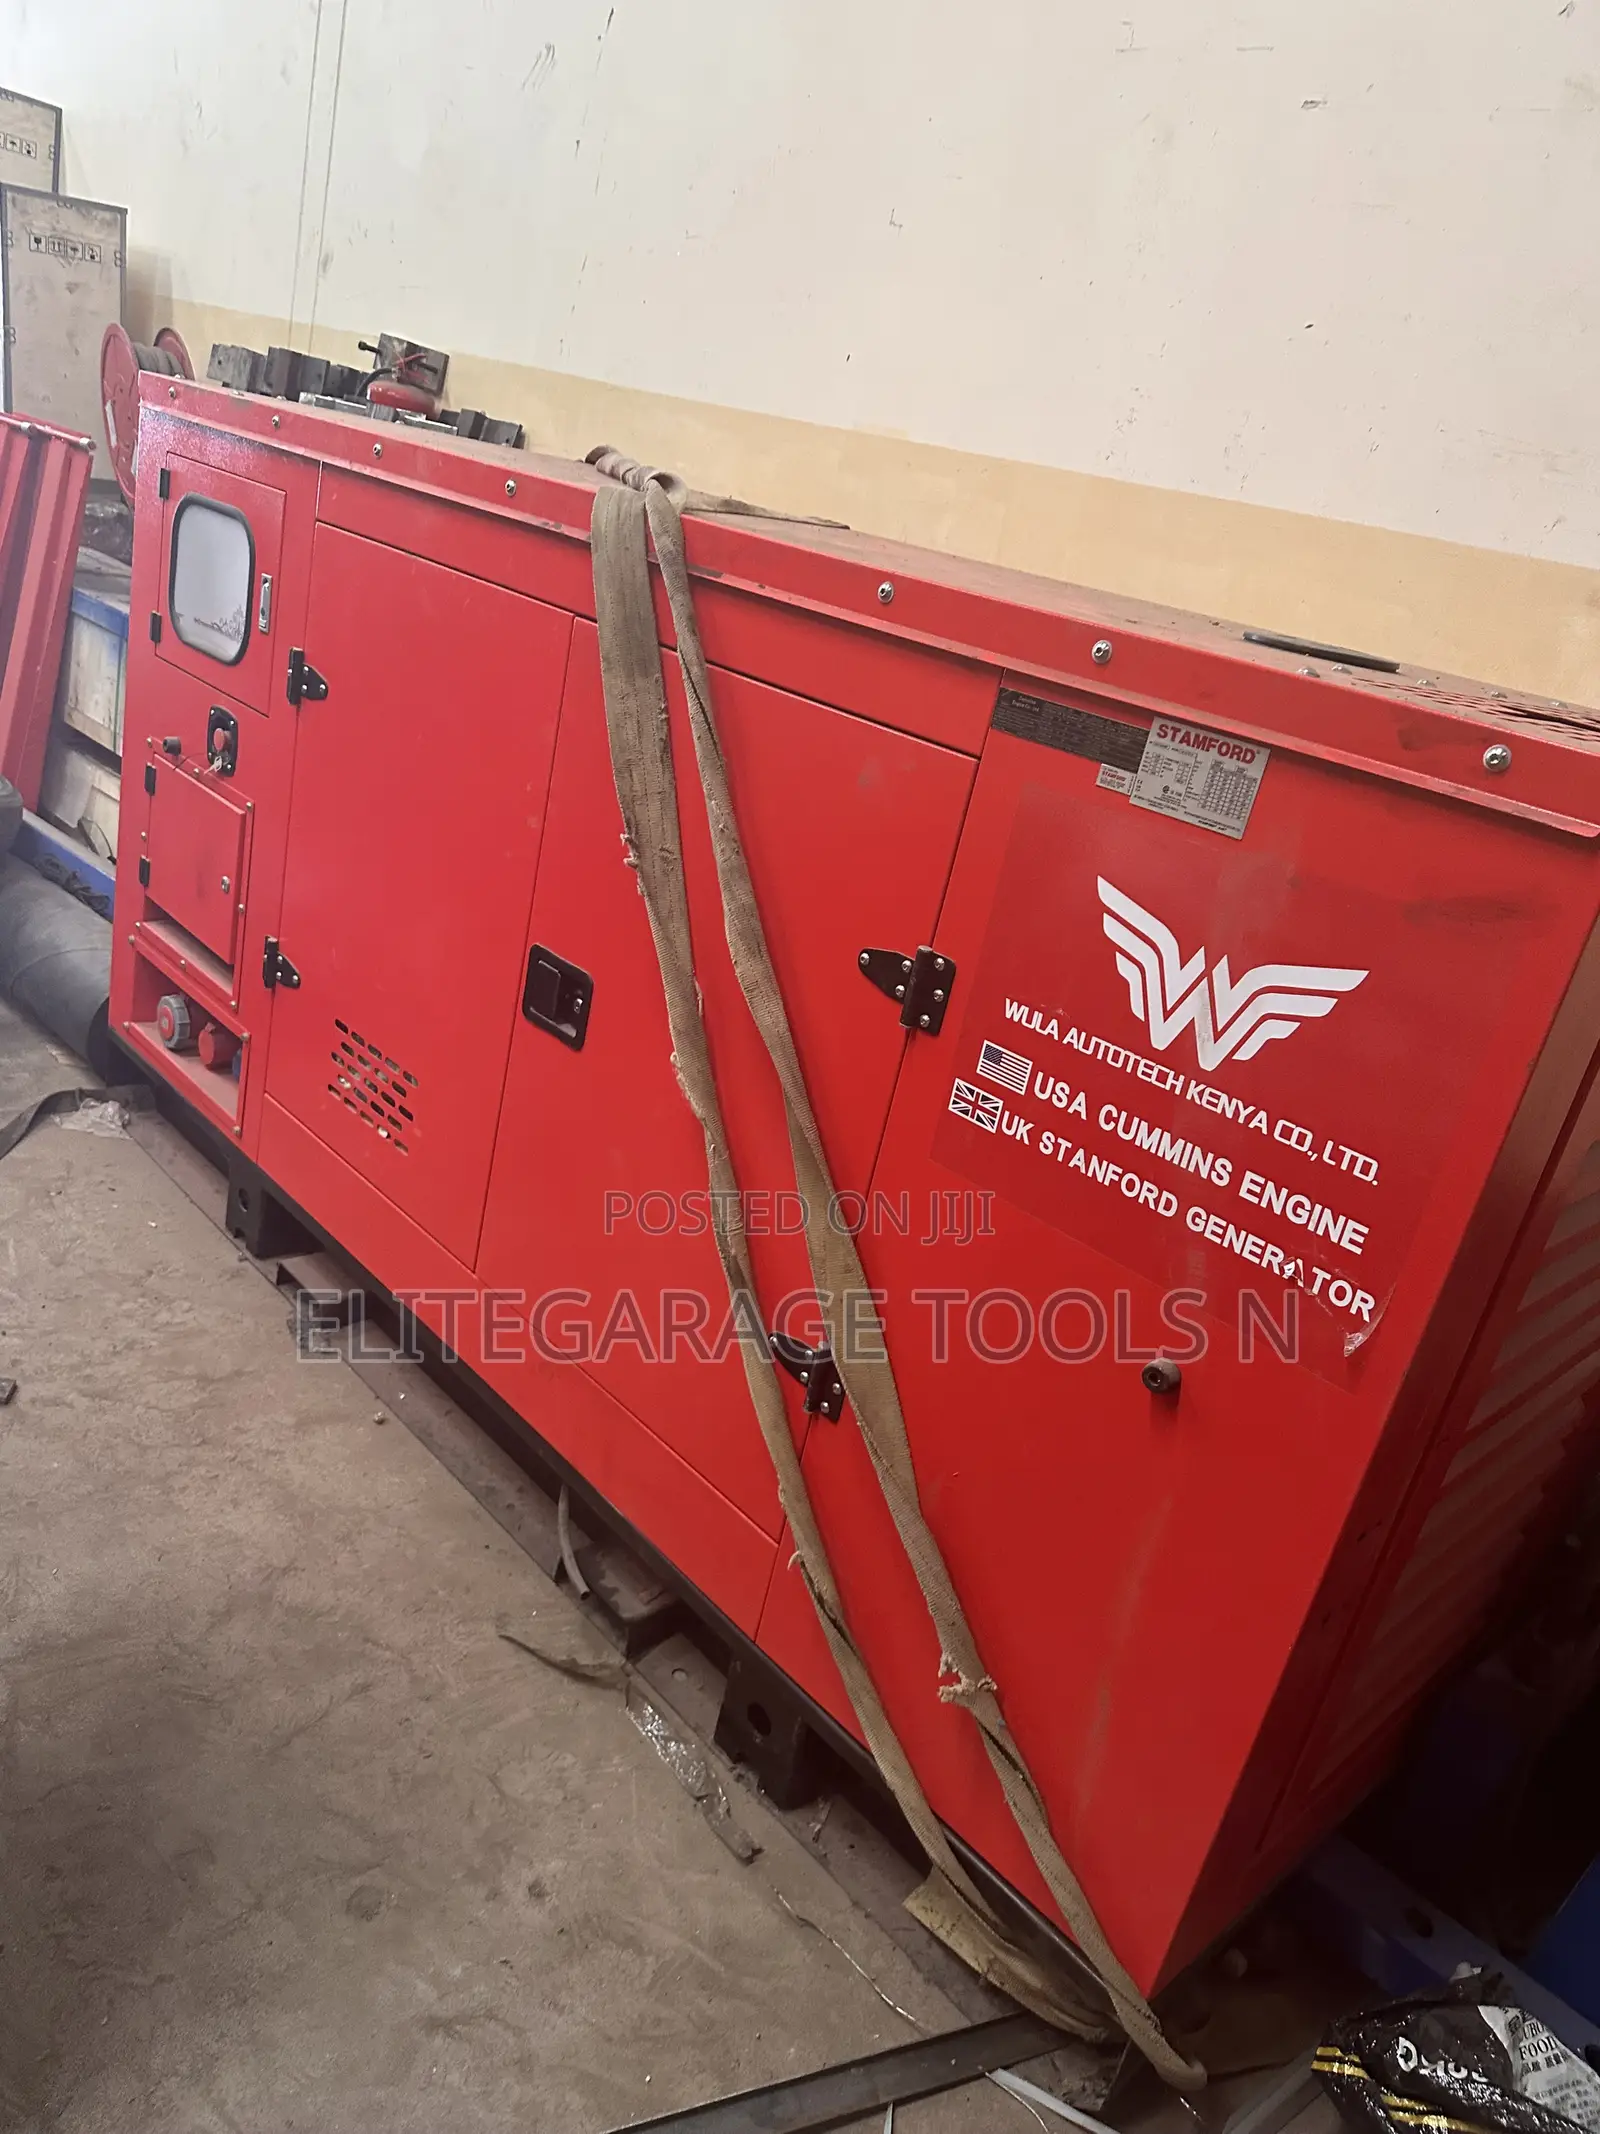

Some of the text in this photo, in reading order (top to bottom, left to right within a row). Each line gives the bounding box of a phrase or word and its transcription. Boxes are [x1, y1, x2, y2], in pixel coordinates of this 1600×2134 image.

[1156, 723, 1256, 765] STAMFORD
[1005, 997, 1059, 1041] WULA
[1062, 1027, 1184, 1096] AUTOTECH
[1186, 1079, 1268, 1135] KENYA
[1322, 1140, 1379, 1187] LTD.
[1034, 1071, 1370, 1255] USA CUMMINS ENGINE
[1001, 1110, 1376, 1323] UK STANFORD GENERATOR
